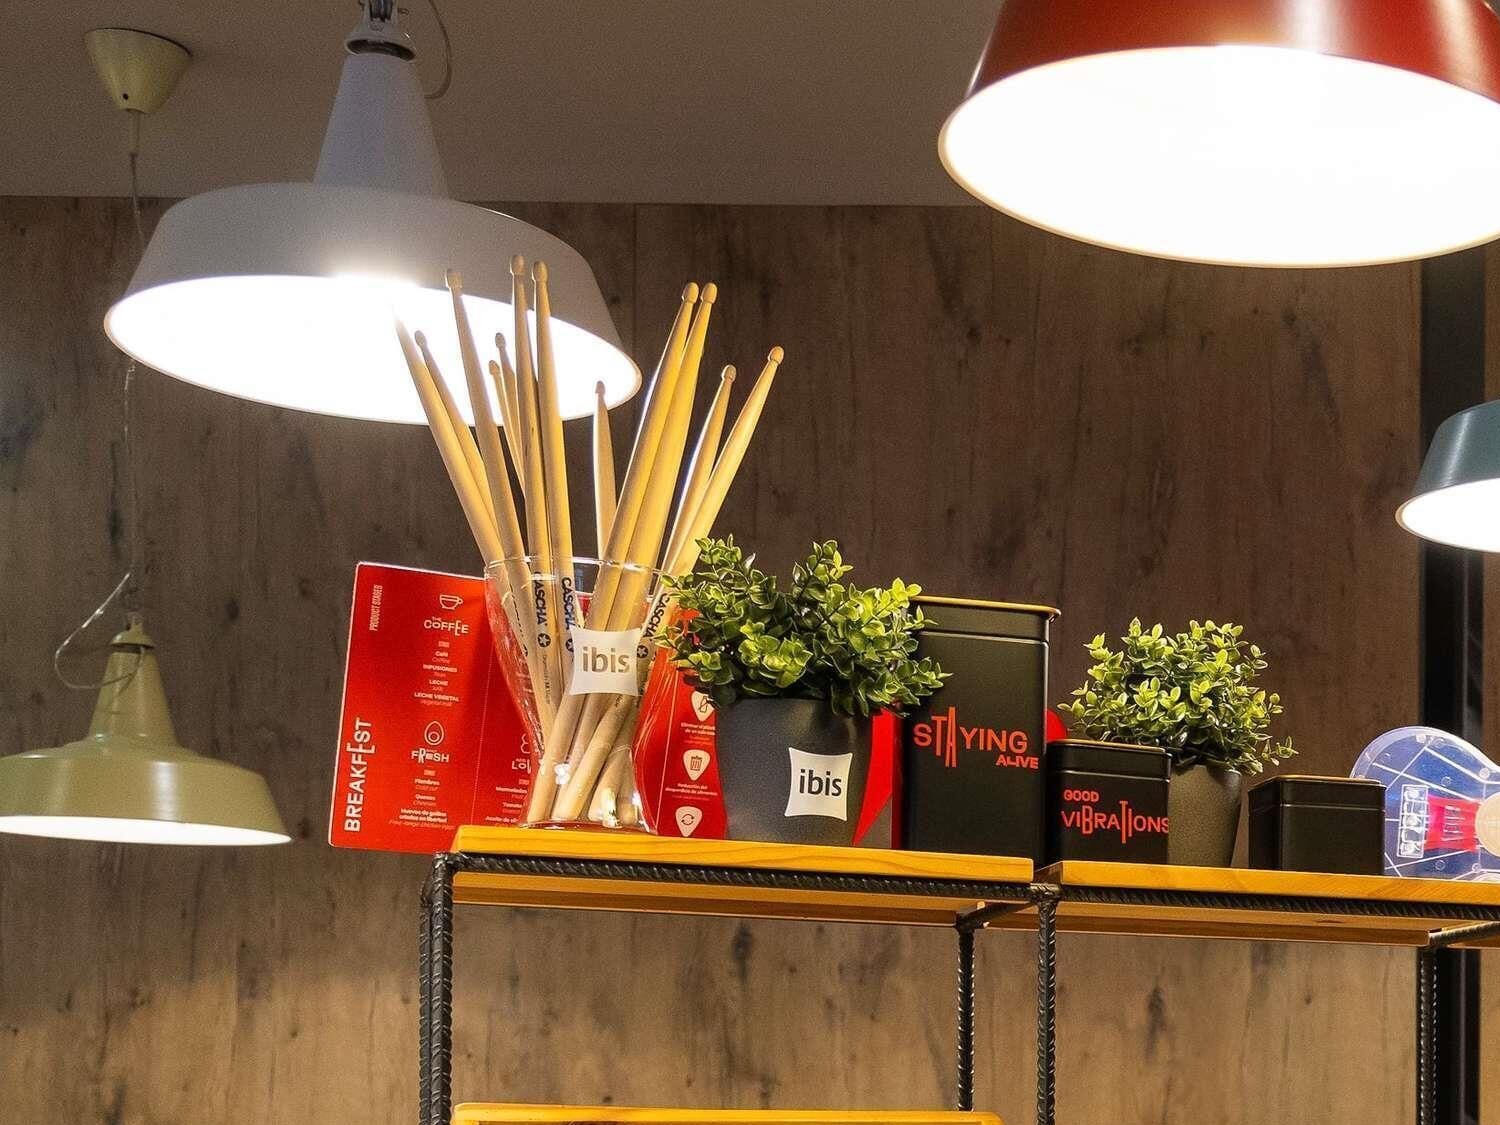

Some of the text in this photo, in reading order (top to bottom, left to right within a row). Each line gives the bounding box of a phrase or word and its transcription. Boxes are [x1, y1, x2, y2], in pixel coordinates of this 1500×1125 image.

[423, 619, 470, 636] COFFEE
[582, 646, 630, 673] ibis
[913, 706, 1029, 768] STAYING
[411, 748, 449, 764] FRESH
[995, 754, 1039, 769] ALIVE
[344, 717, 376, 832] BREAKFEST
[799, 768, 842, 797] ibis
[1063, 789, 1100, 803] GOOD
[1061, 800, 1169, 844] VIBRATIONS
